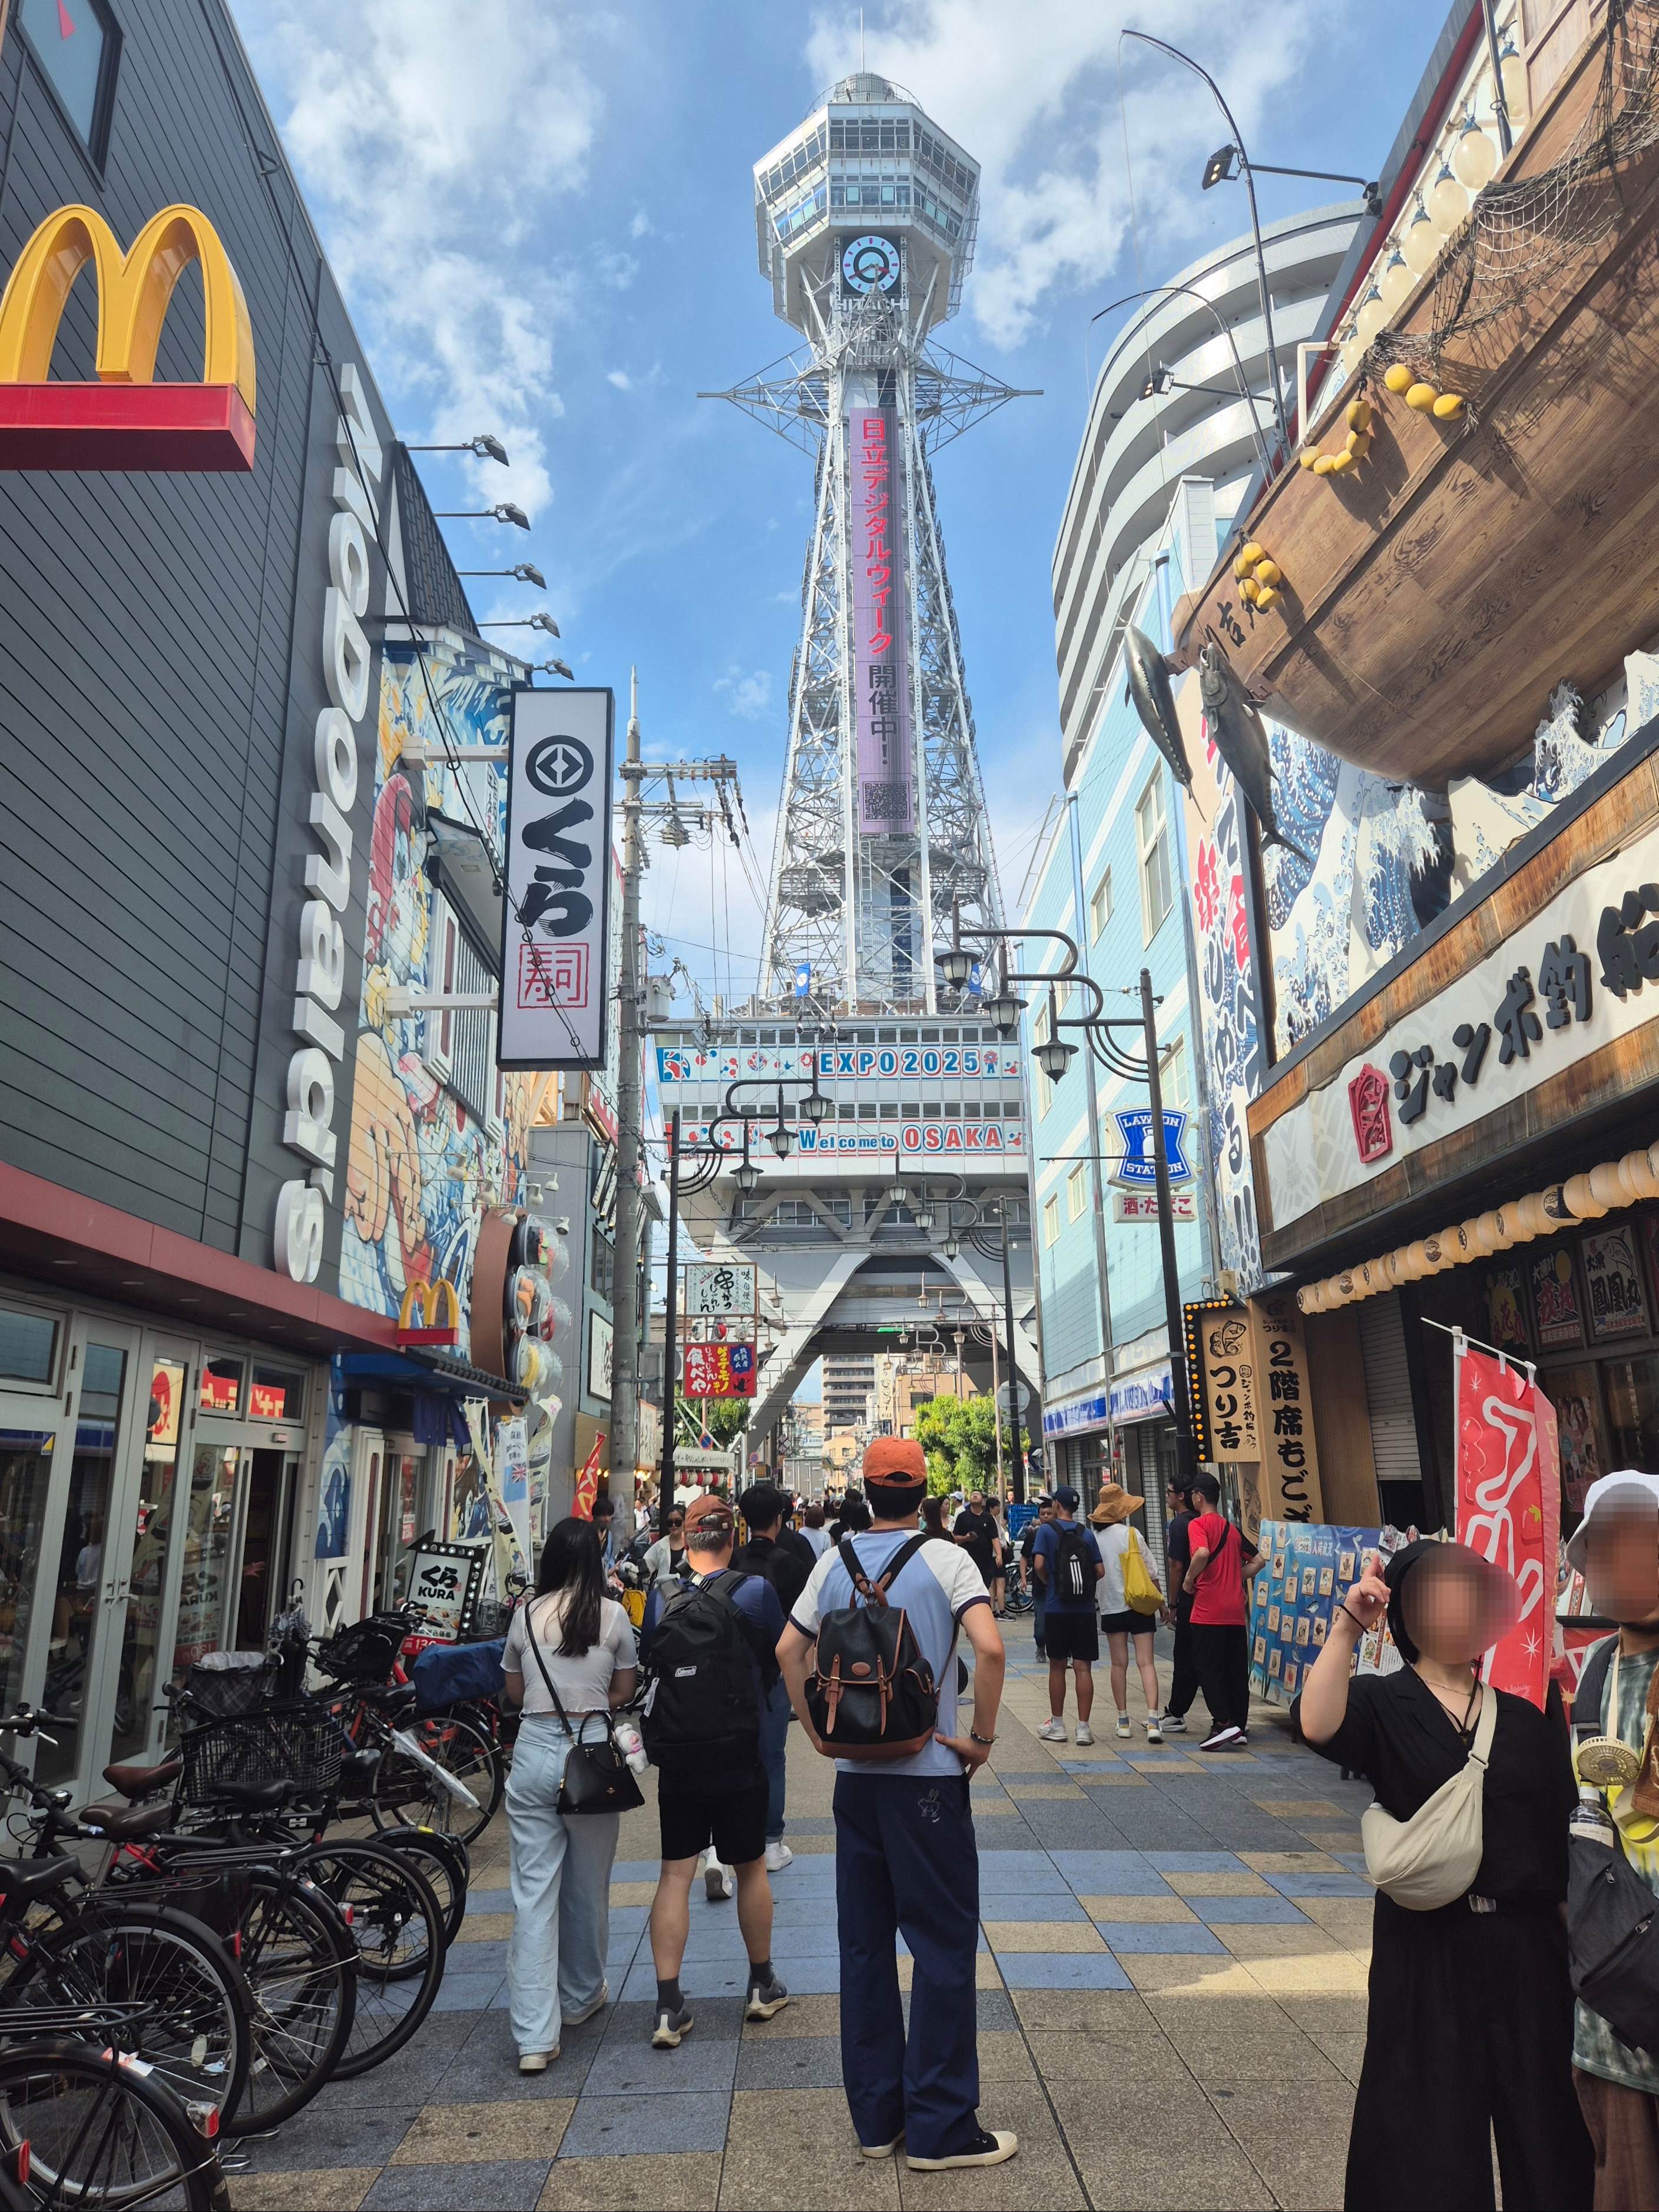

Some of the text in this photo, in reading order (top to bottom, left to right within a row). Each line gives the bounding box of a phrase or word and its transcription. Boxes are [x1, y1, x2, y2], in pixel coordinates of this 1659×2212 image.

[274, 363, 383, 1282] McDonald's
[522, 797, 594, 937] くら
[524, 947, 585, 1004] 寿司
[819, 1050, 979, 1075] EXPO 2025
[1122, 1115, 1180, 1127] LAWON
[905, 1127, 1001, 1149] OSAKA
[1210, 1365, 1243, 1450] つり吉
[421, 1566, 459, 1588] くら
[418, 1586, 455, 1601] KURA
